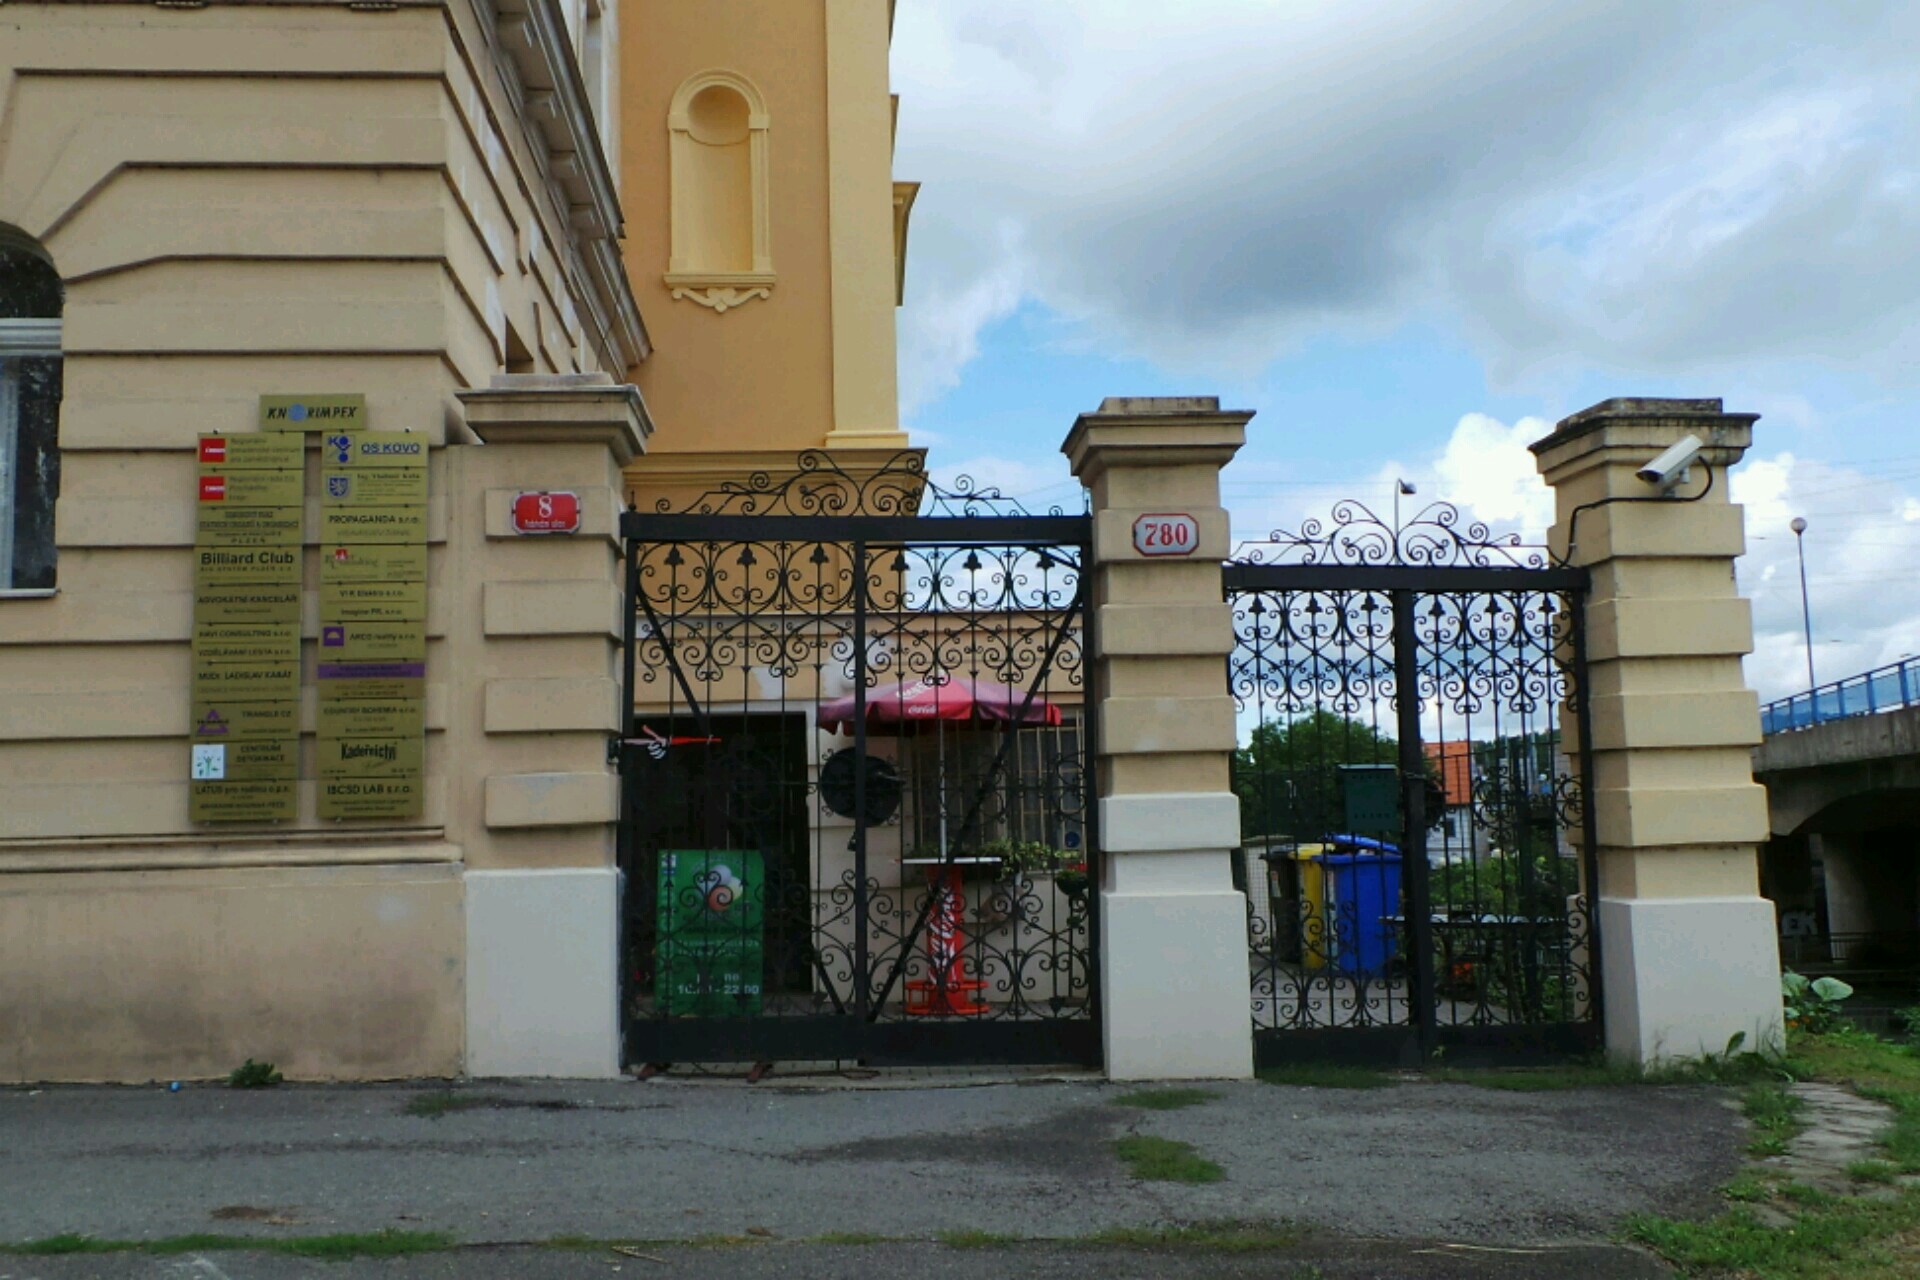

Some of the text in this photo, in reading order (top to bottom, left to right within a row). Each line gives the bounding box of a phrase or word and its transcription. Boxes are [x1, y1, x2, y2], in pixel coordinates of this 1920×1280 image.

[361, 443, 420, 454] OS KOVO
[538, 495, 552, 518] 8
[329, 515, 396, 524] PROPAGANDA
[1144, 522, 1189, 547] 780
[201, 552, 294, 565] Billiard Club
